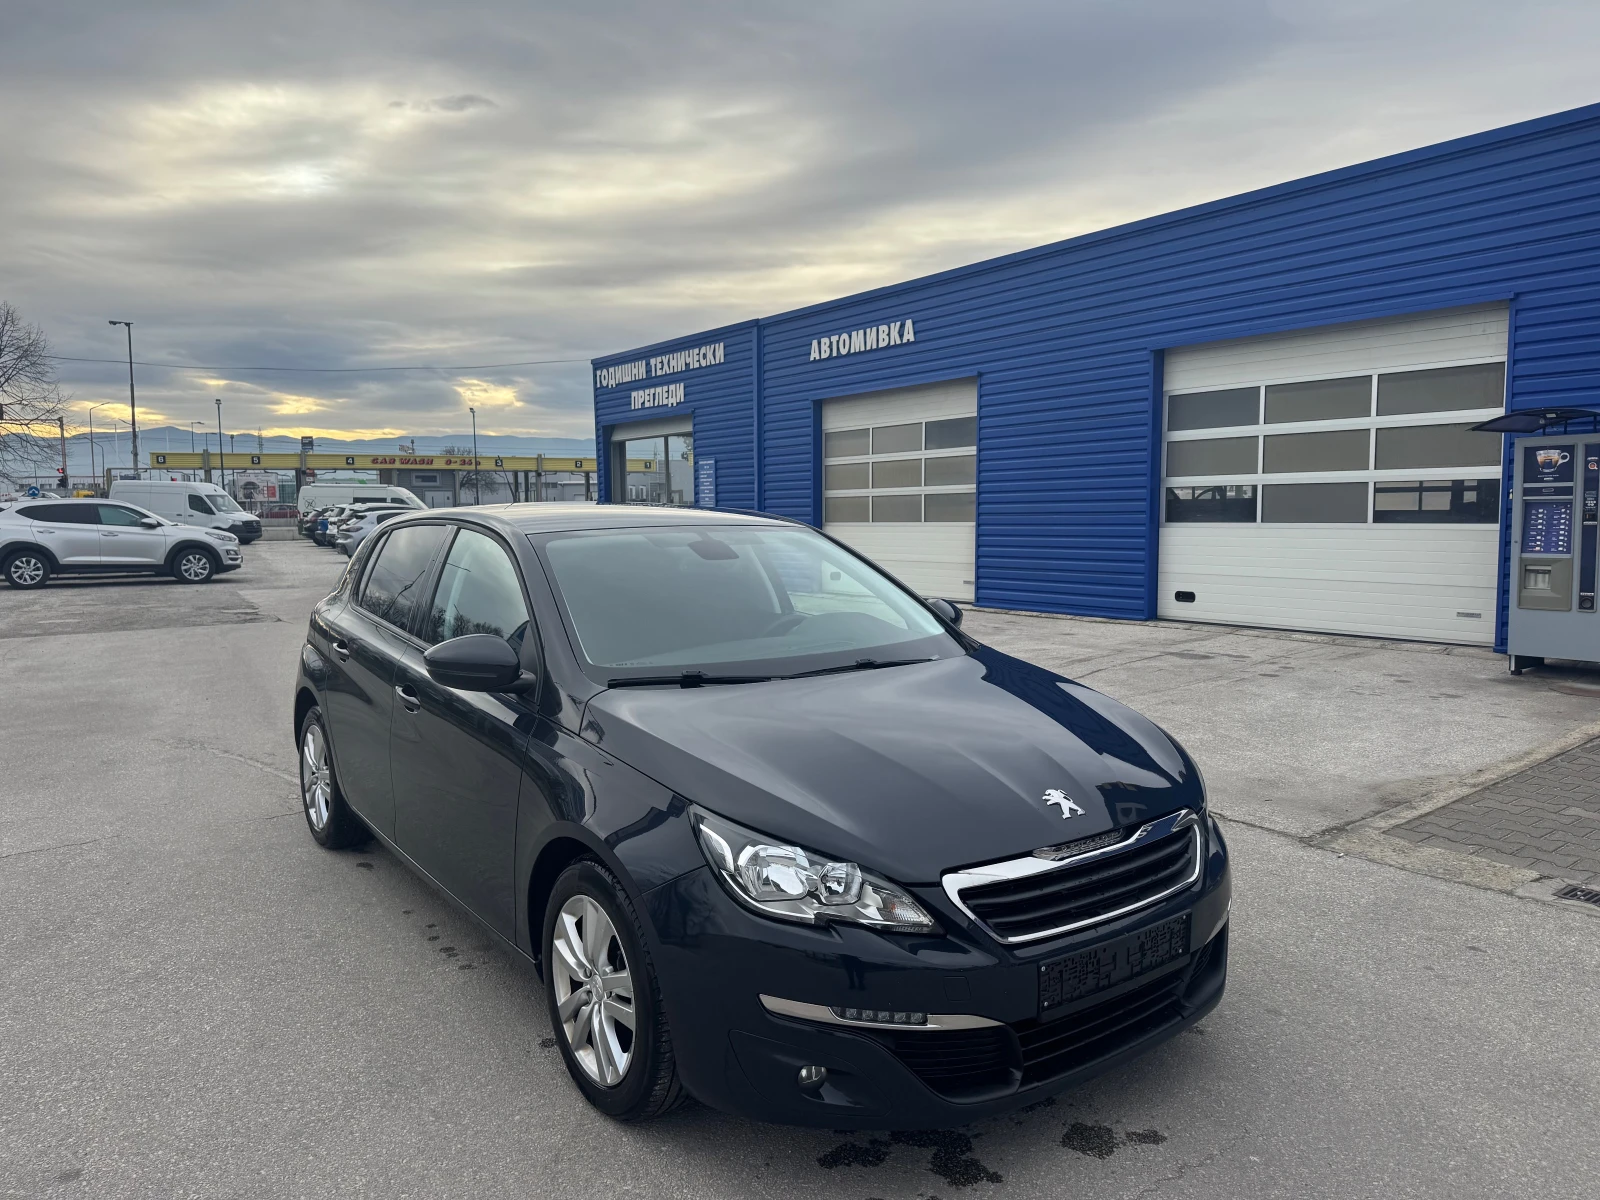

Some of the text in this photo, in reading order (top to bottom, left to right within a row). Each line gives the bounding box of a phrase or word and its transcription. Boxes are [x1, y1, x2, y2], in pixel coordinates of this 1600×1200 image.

[810, 319, 915, 361] АВТОМИВКА
[596, 342, 725, 388] ГОДИШНИ ТЕХНИЧЕСКИ
[631, 383, 685, 410] ПРЕГЛЕДИ
[371, 457, 396, 466] CAR
[399, 457, 434, 466] WASH
